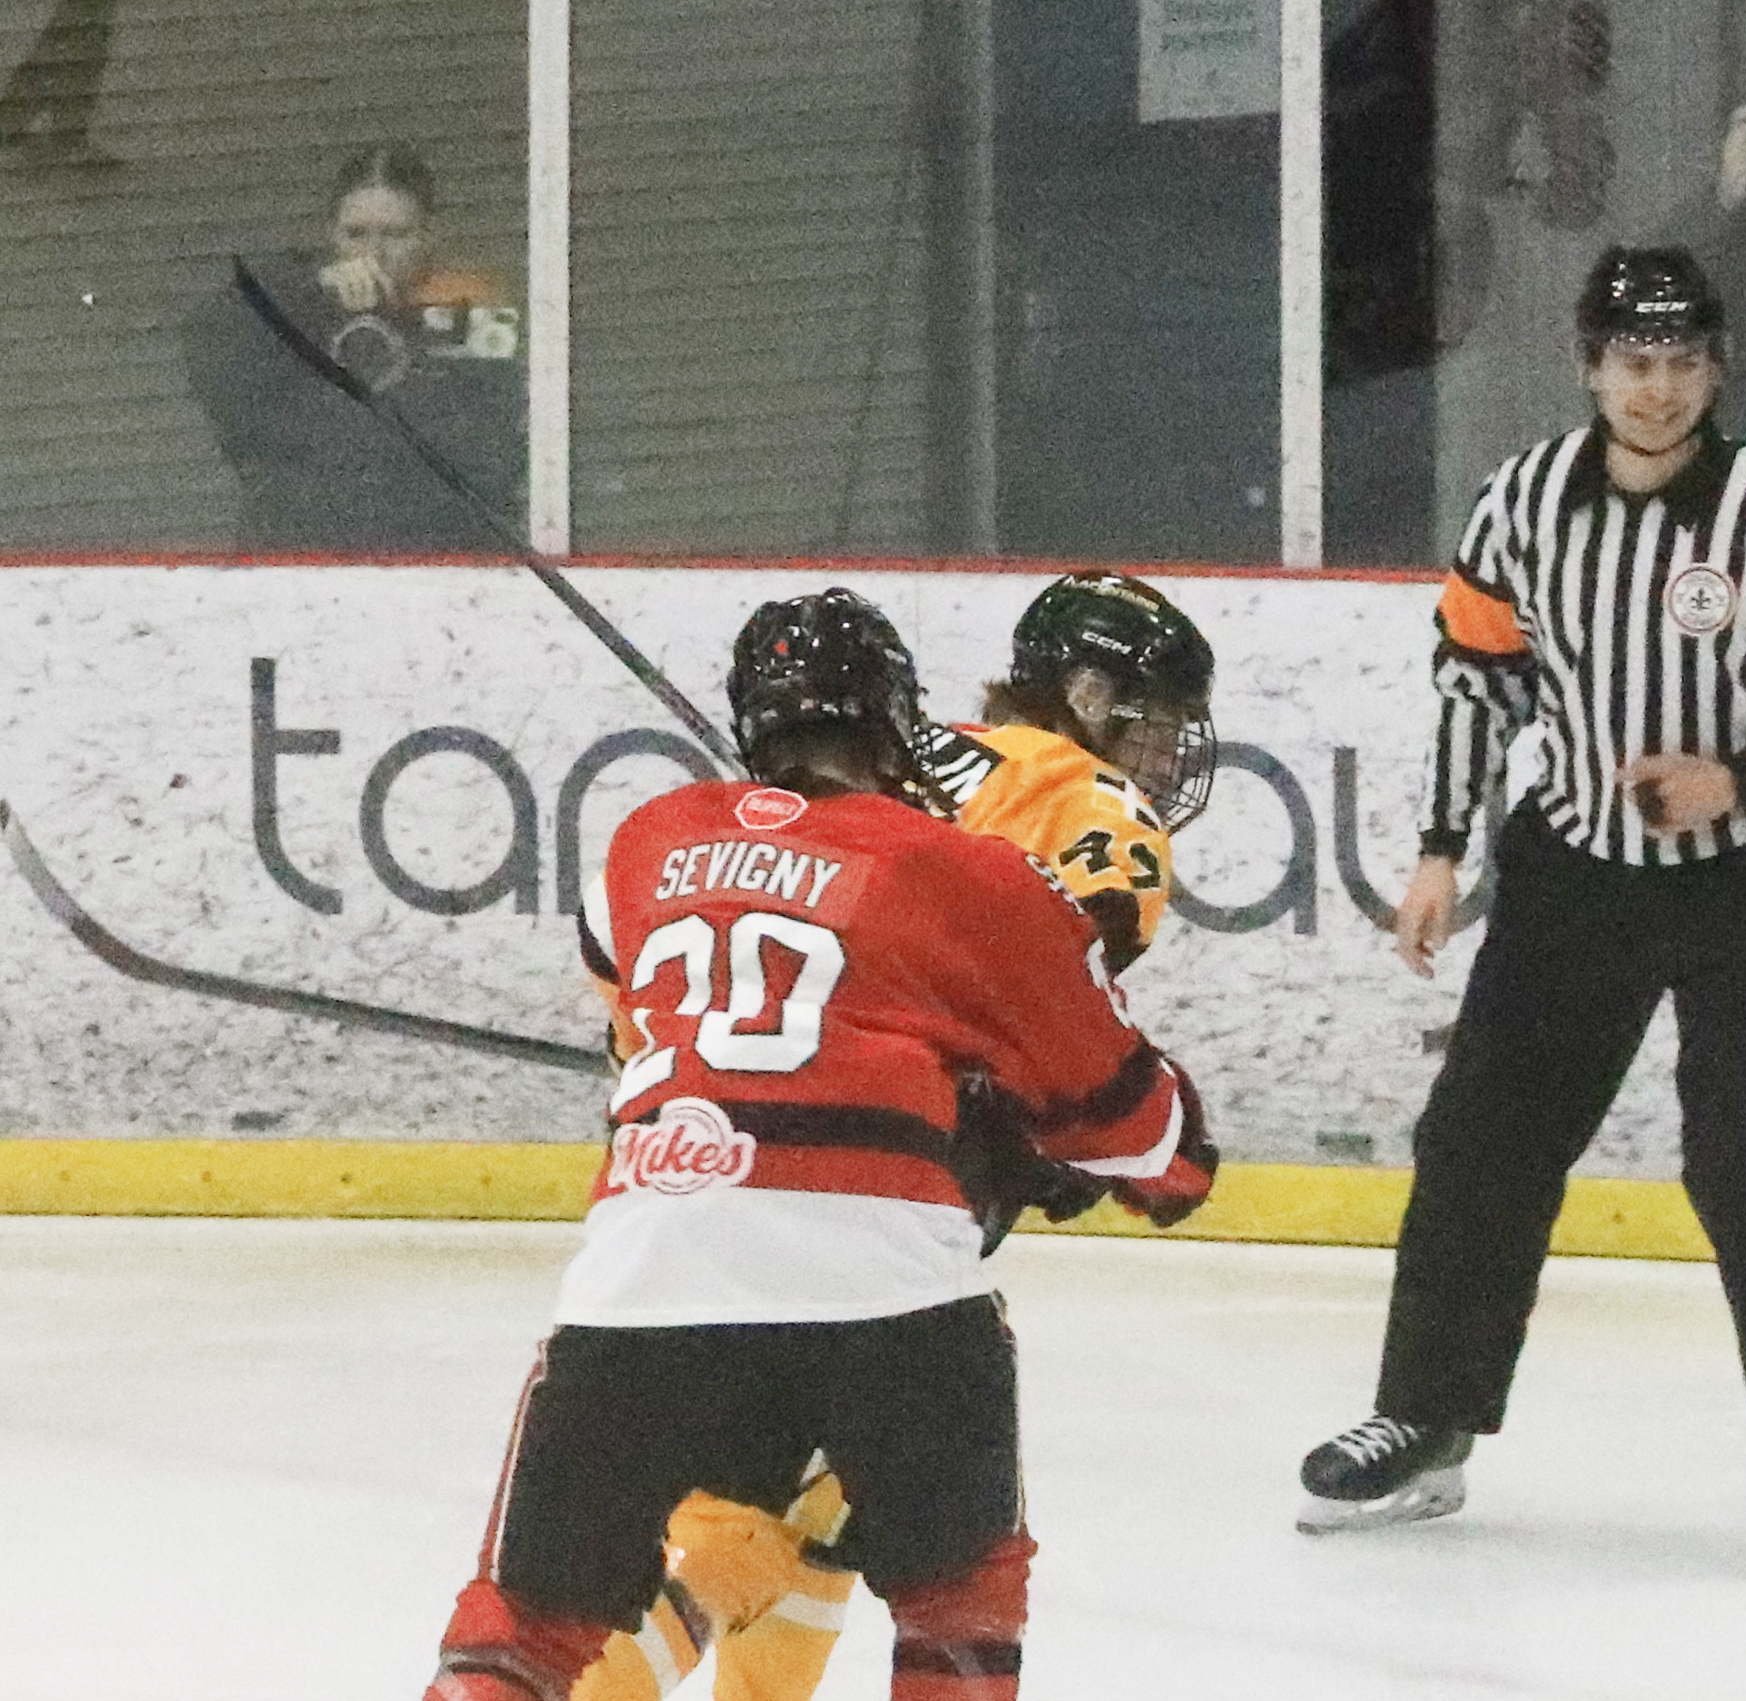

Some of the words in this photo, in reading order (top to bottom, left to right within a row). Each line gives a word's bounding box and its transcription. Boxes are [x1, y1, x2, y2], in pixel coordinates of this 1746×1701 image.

[1081, 631, 1133, 655] CCM
[655, 840, 842, 908] SEVIGNY
[610, 911, 847, 1116] 20
